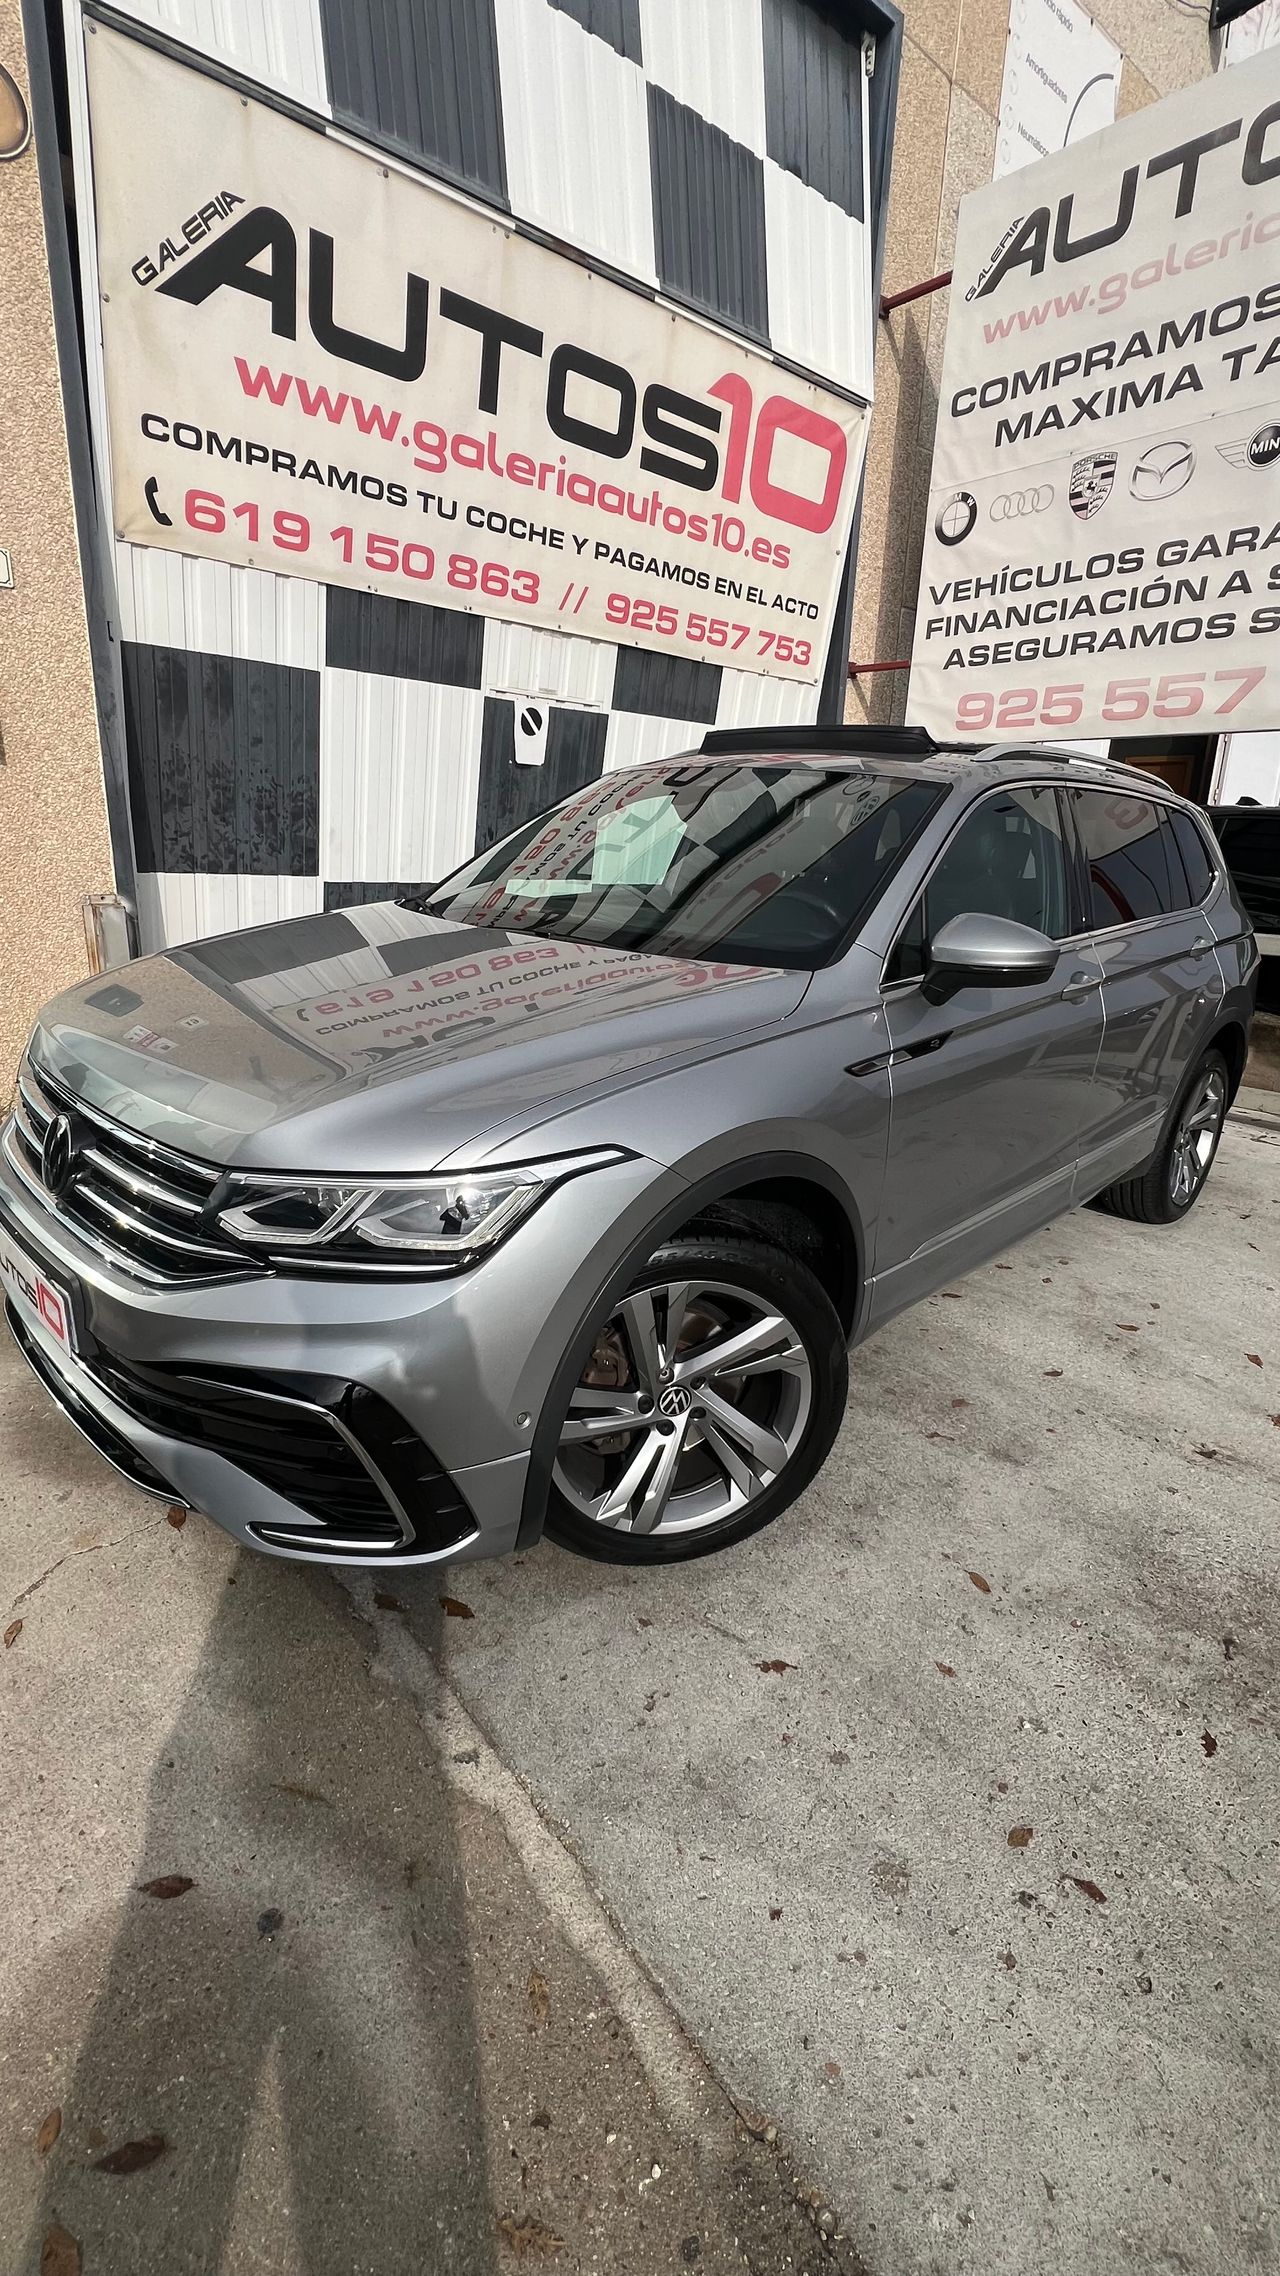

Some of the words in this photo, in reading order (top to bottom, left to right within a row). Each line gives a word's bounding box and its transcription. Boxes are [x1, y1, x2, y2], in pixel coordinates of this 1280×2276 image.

[131, 190, 246, 287] GALERIA
[965, 215, 1025, 302] GALERIA
[154, 205, 848, 534] AUTOS10
[994, 362, 1204, 448] MAXIMA
[233, 356, 791, 570] www.galeriaautos10.es
[141, 412, 408, 508] COMPRAMOS
[416, 490, 458, 521] TU
[465, 505, 565, 551] COCHE
[571, 535, 591, 555] Y
[594, 542, 711, 589] PAGAMOS
[715, 576, 744, 600] EN
[746, 587, 768, 607] EL
[771, 594, 820, 620] ACTO
[184, 488, 310, 552] 619
[329, 525, 435, 581] 150
[447, 553, 541, 605] 863
[604, 592, 680, 636] 925
[685, 614, 752, 651] 557
[756, 630, 813, 667] 753
[925, 574, 1209, 640] FINANCIACIÓN
[1217, 570, 1253, 600] A
[929, 547, 1145, 606] VEHÍCULOS
[942, 612, 1237, 671] ASEGURAMOS
[955, 683, 1085, 732] 925
[1101, 665, 1267, 722] 557
